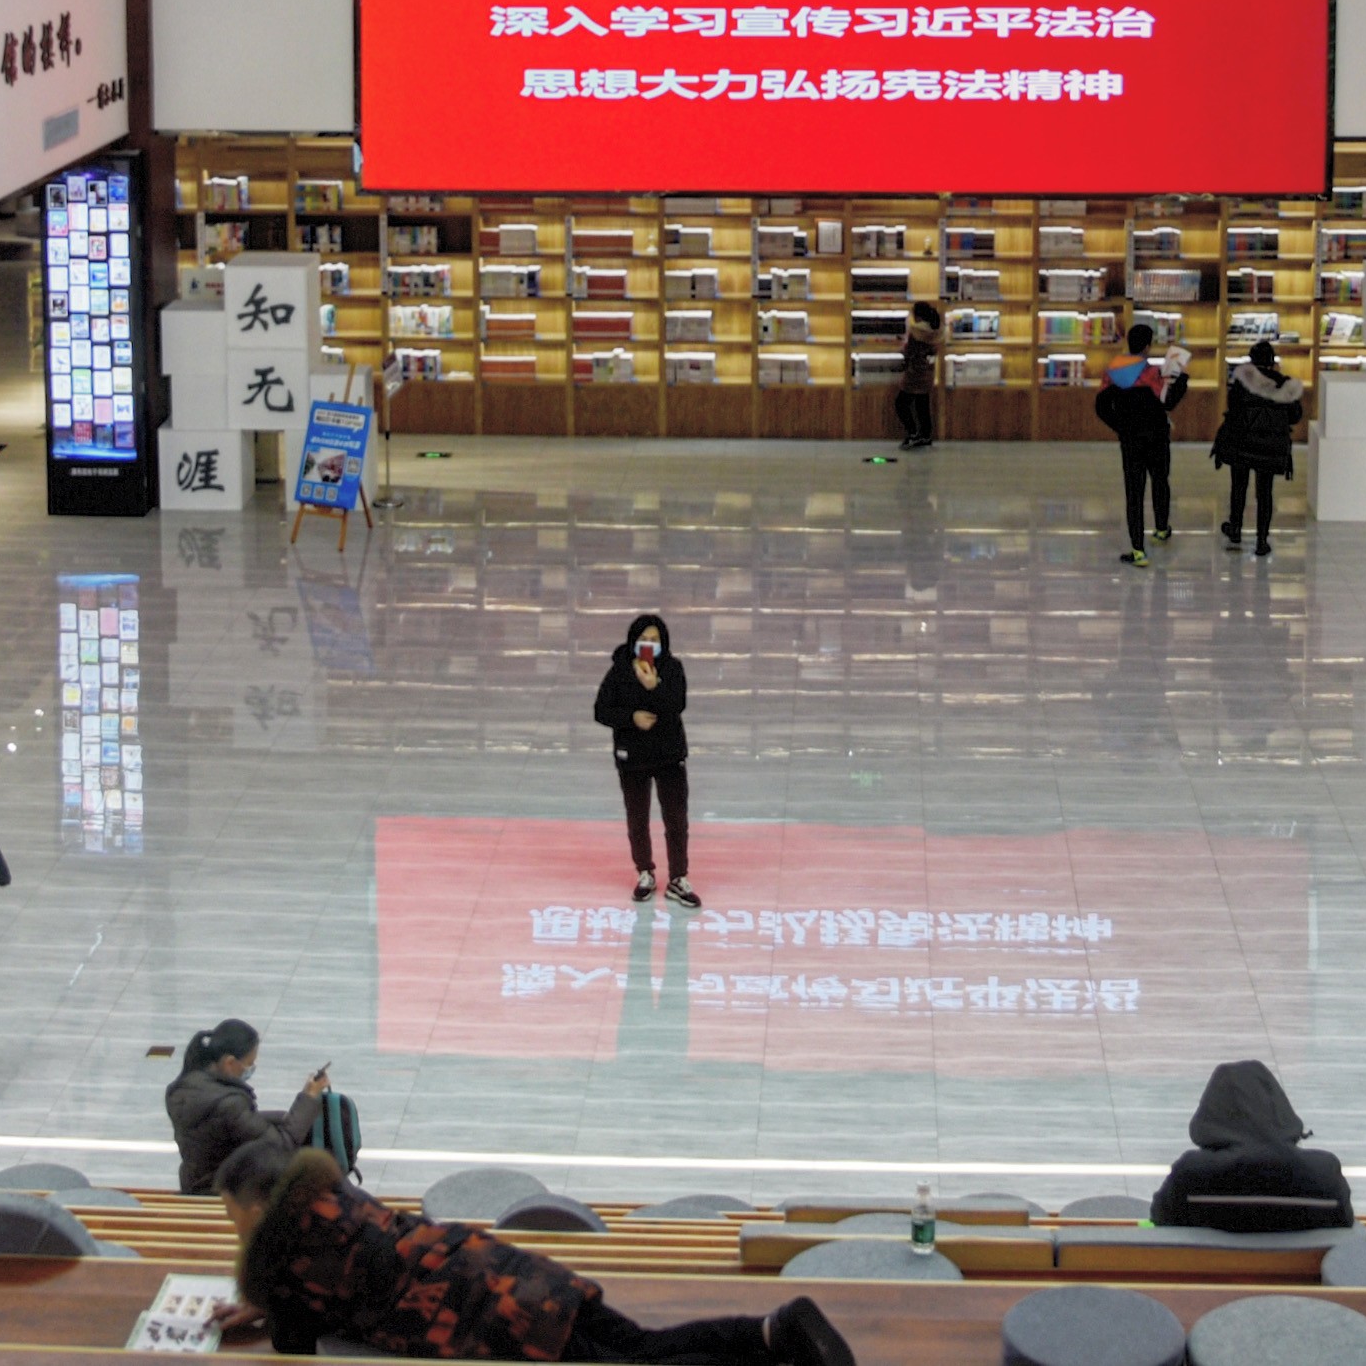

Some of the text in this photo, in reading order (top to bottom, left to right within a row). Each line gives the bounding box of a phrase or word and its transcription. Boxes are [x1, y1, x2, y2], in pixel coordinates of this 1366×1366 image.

[489, 5, 1156, 39] 深入学习宣传习近平法治
[520, 68, 1124, 101] 思想大力弘扬宪法精神
[237, 283, 295, 331] 知
[242, 366, 294, 412] 无
[176, 449, 225, 493] 涯
